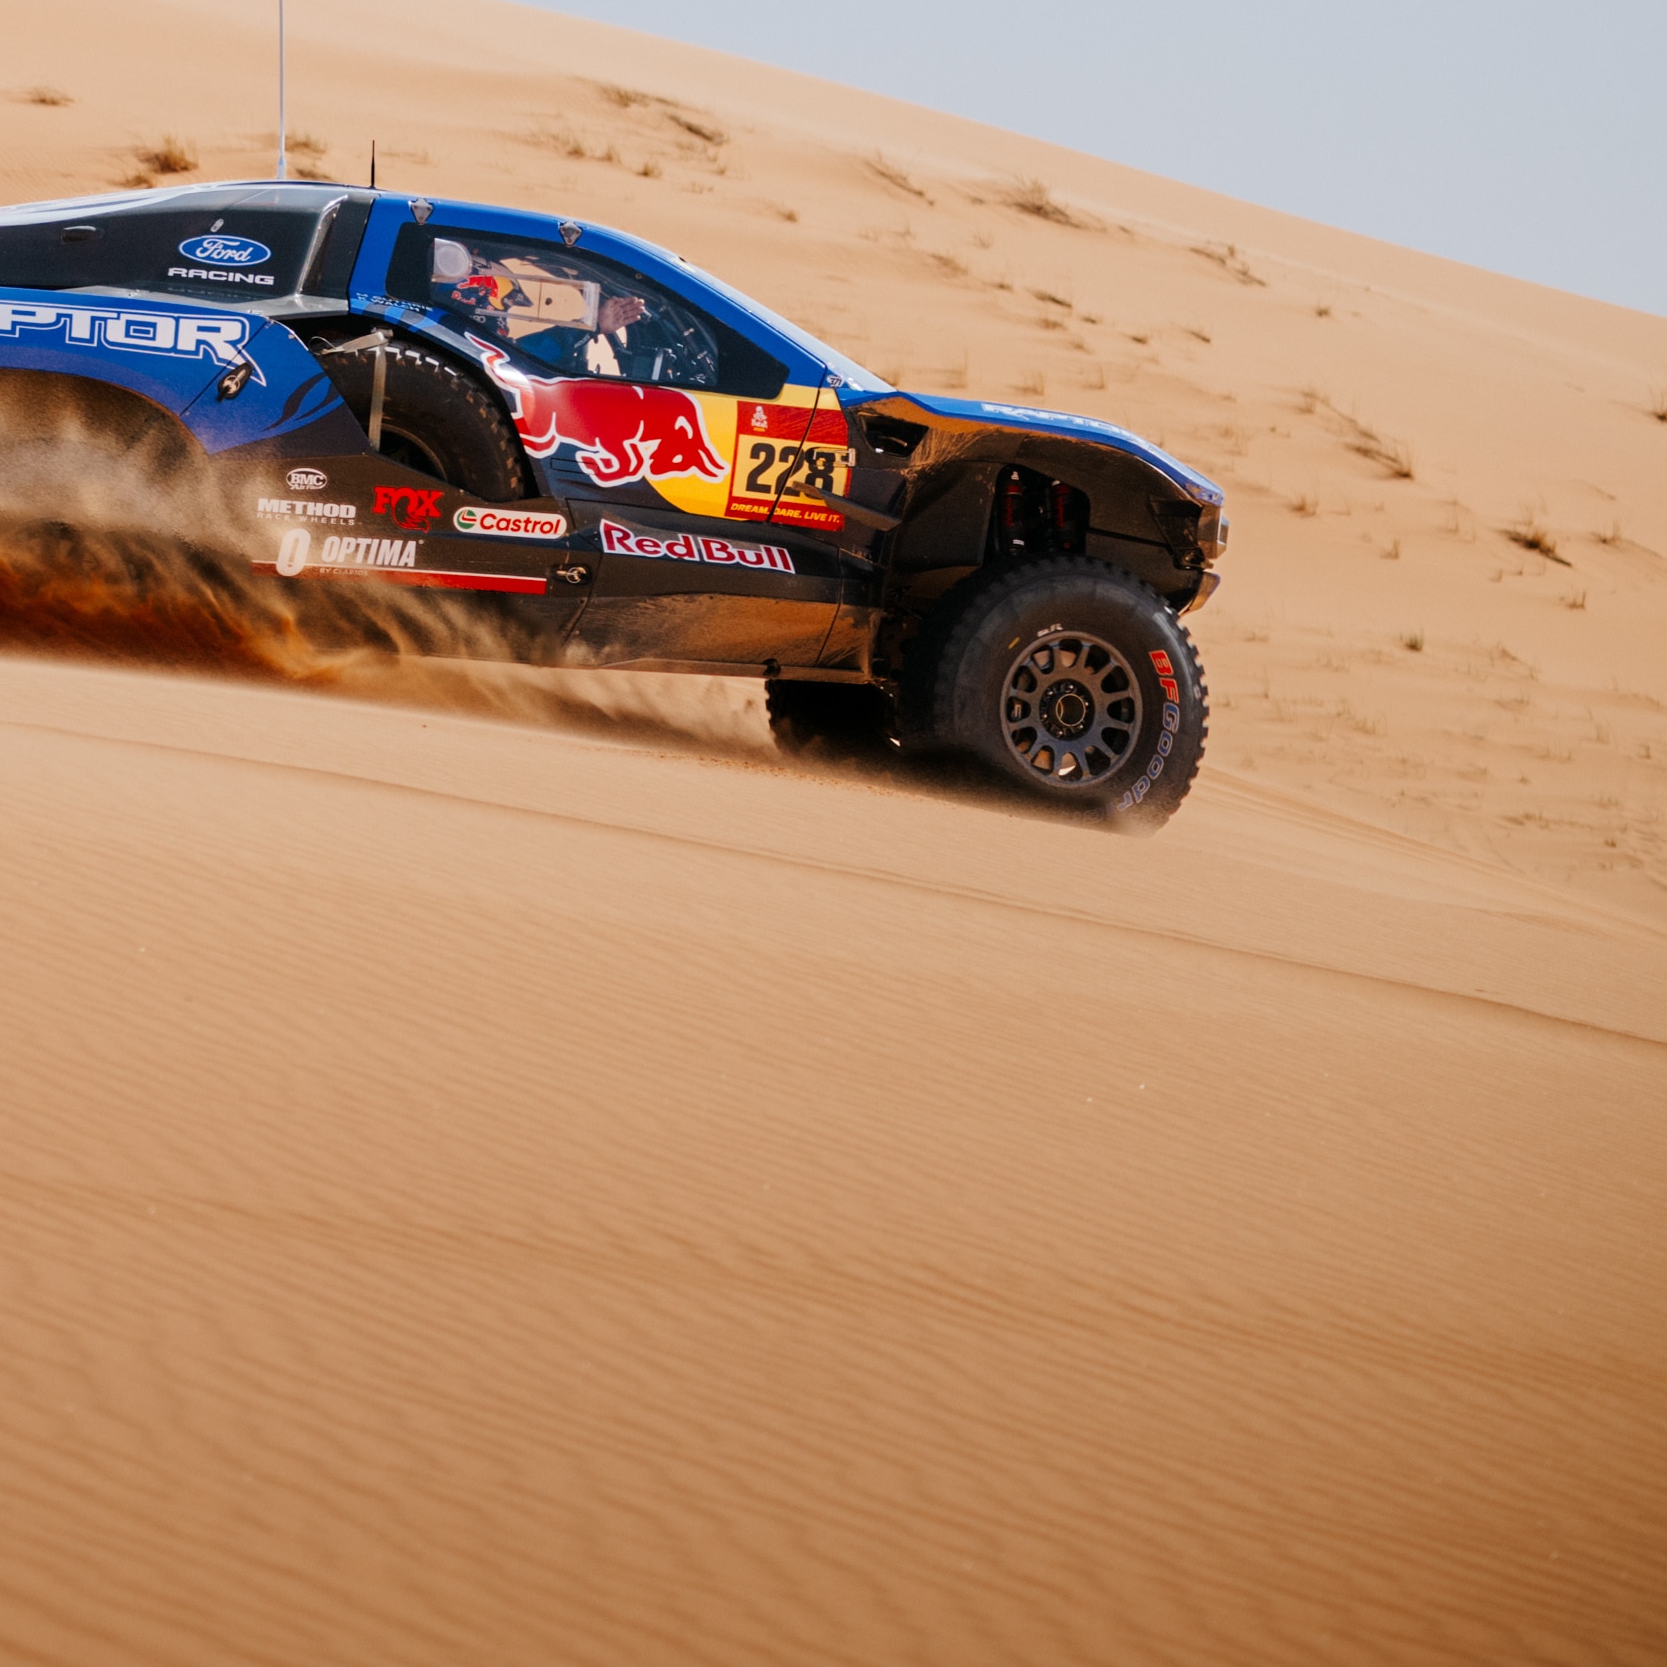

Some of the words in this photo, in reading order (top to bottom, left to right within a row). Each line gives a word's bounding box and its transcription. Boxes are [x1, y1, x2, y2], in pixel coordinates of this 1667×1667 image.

[195, 238, 254, 262] Ford
[167, 267, 275, 286] RACING
[290, 473, 324, 486] BMC
[746, 442, 835, 499] 228
[257, 498, 356, 519] METHOD
[257, 512, 291, 521] RACE
[299, 515, 355, 526] WHEELS
[372, 485, 443, 533] FOX
[730, 503, 771, 515] DREAM.
[773, 506, 803, 518] DARE.
[804, 510, 827, 521] LIVE
[828, 514, 840, 523] IT.
[479, 512, 561, 535] Castrol
[321, 536, 417, 567] OPTIMA
[602, 520, 697, 559] Red
[700, 537, 794, 572] Bull
[1083, 649, 1180, 823] BFGoodr
